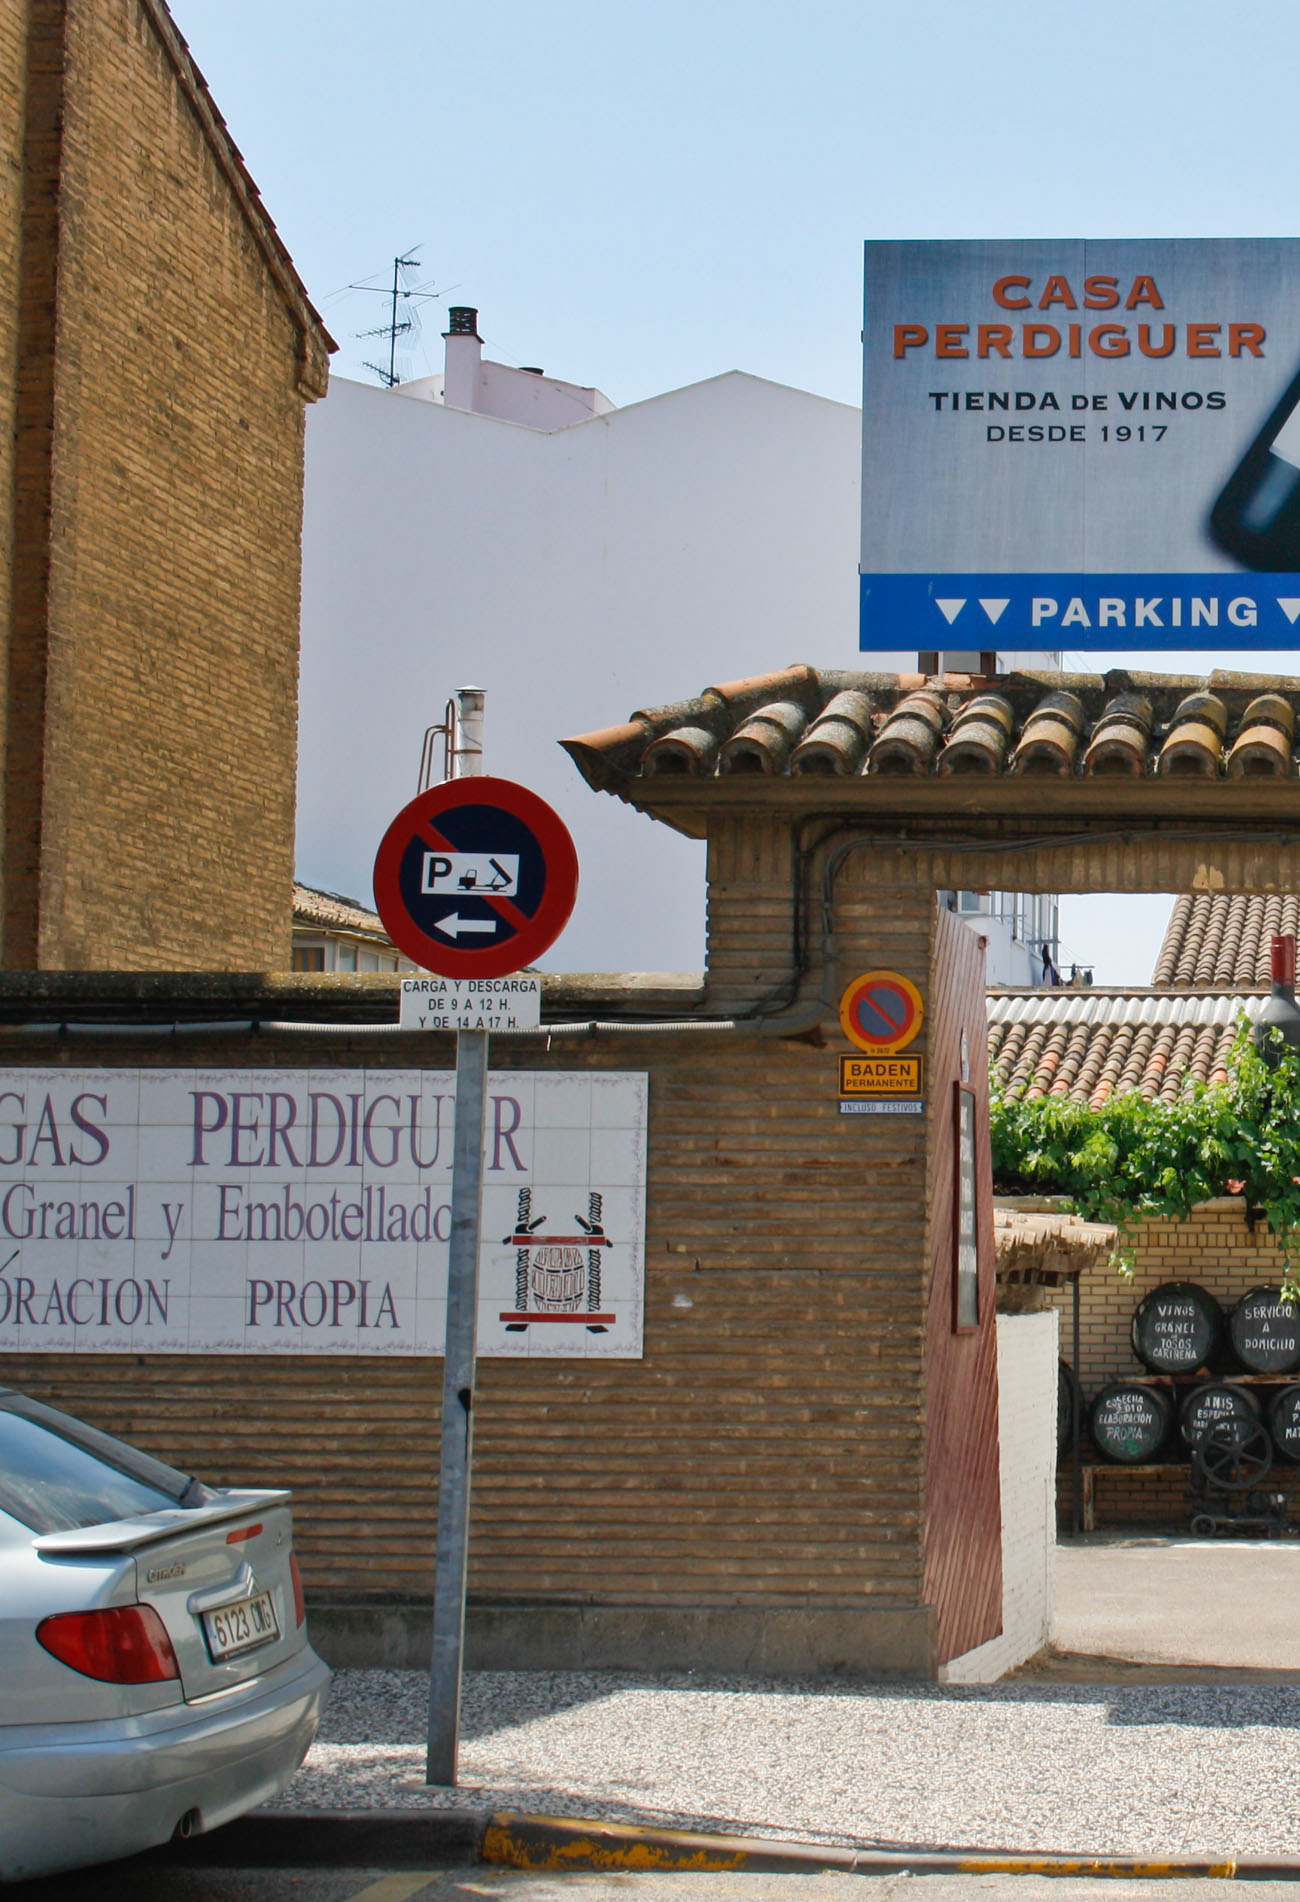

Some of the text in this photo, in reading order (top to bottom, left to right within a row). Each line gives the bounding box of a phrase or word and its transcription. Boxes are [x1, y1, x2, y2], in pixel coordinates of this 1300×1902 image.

[992, 275, 1165, 310] CASA
[893, 322, 1266, 358] PERDIGUER
[929, 391, 1227, 411] TIENDA DE VINOS
[986, 425, 1168, 442] DESDE 1917
[1031, 597, 1259, 627] PARKING
[427, 857, 453, 888] P
[403, 980, 538, 992] CARGA Y DESCARGA
[428, 999, 511, 1010] DE 9 A 12 H.
[418, 1016, 520, 1028] Y DE 14 A 17 H.
[851, 1063, 911, 1076] BADEN
[846, 1078, 916, 1087] PERMANENTE
[844, 1103, 919, 1112] INCLUSO FESTIVOS
[186, 1091, 528, 1171] PERDIGUR
[2, 1183, 453, 1260] Granel y Embotellado
[245, 1279, 400, 1328] PROPIA
[1157, 1305, 1196, 1317] VINOS
[1245, 1305, 1293, 1319] SERVICIO
[1262, 1322, 1270, 1333] A
[1244, 1338, 1295, 1350] DOMICILIO
[1204, 1396, 1233, 1410] ANIS
[1106, 1426, 1143, 1440] PROPIA
[214, 1605, 250, 1647] 6123
